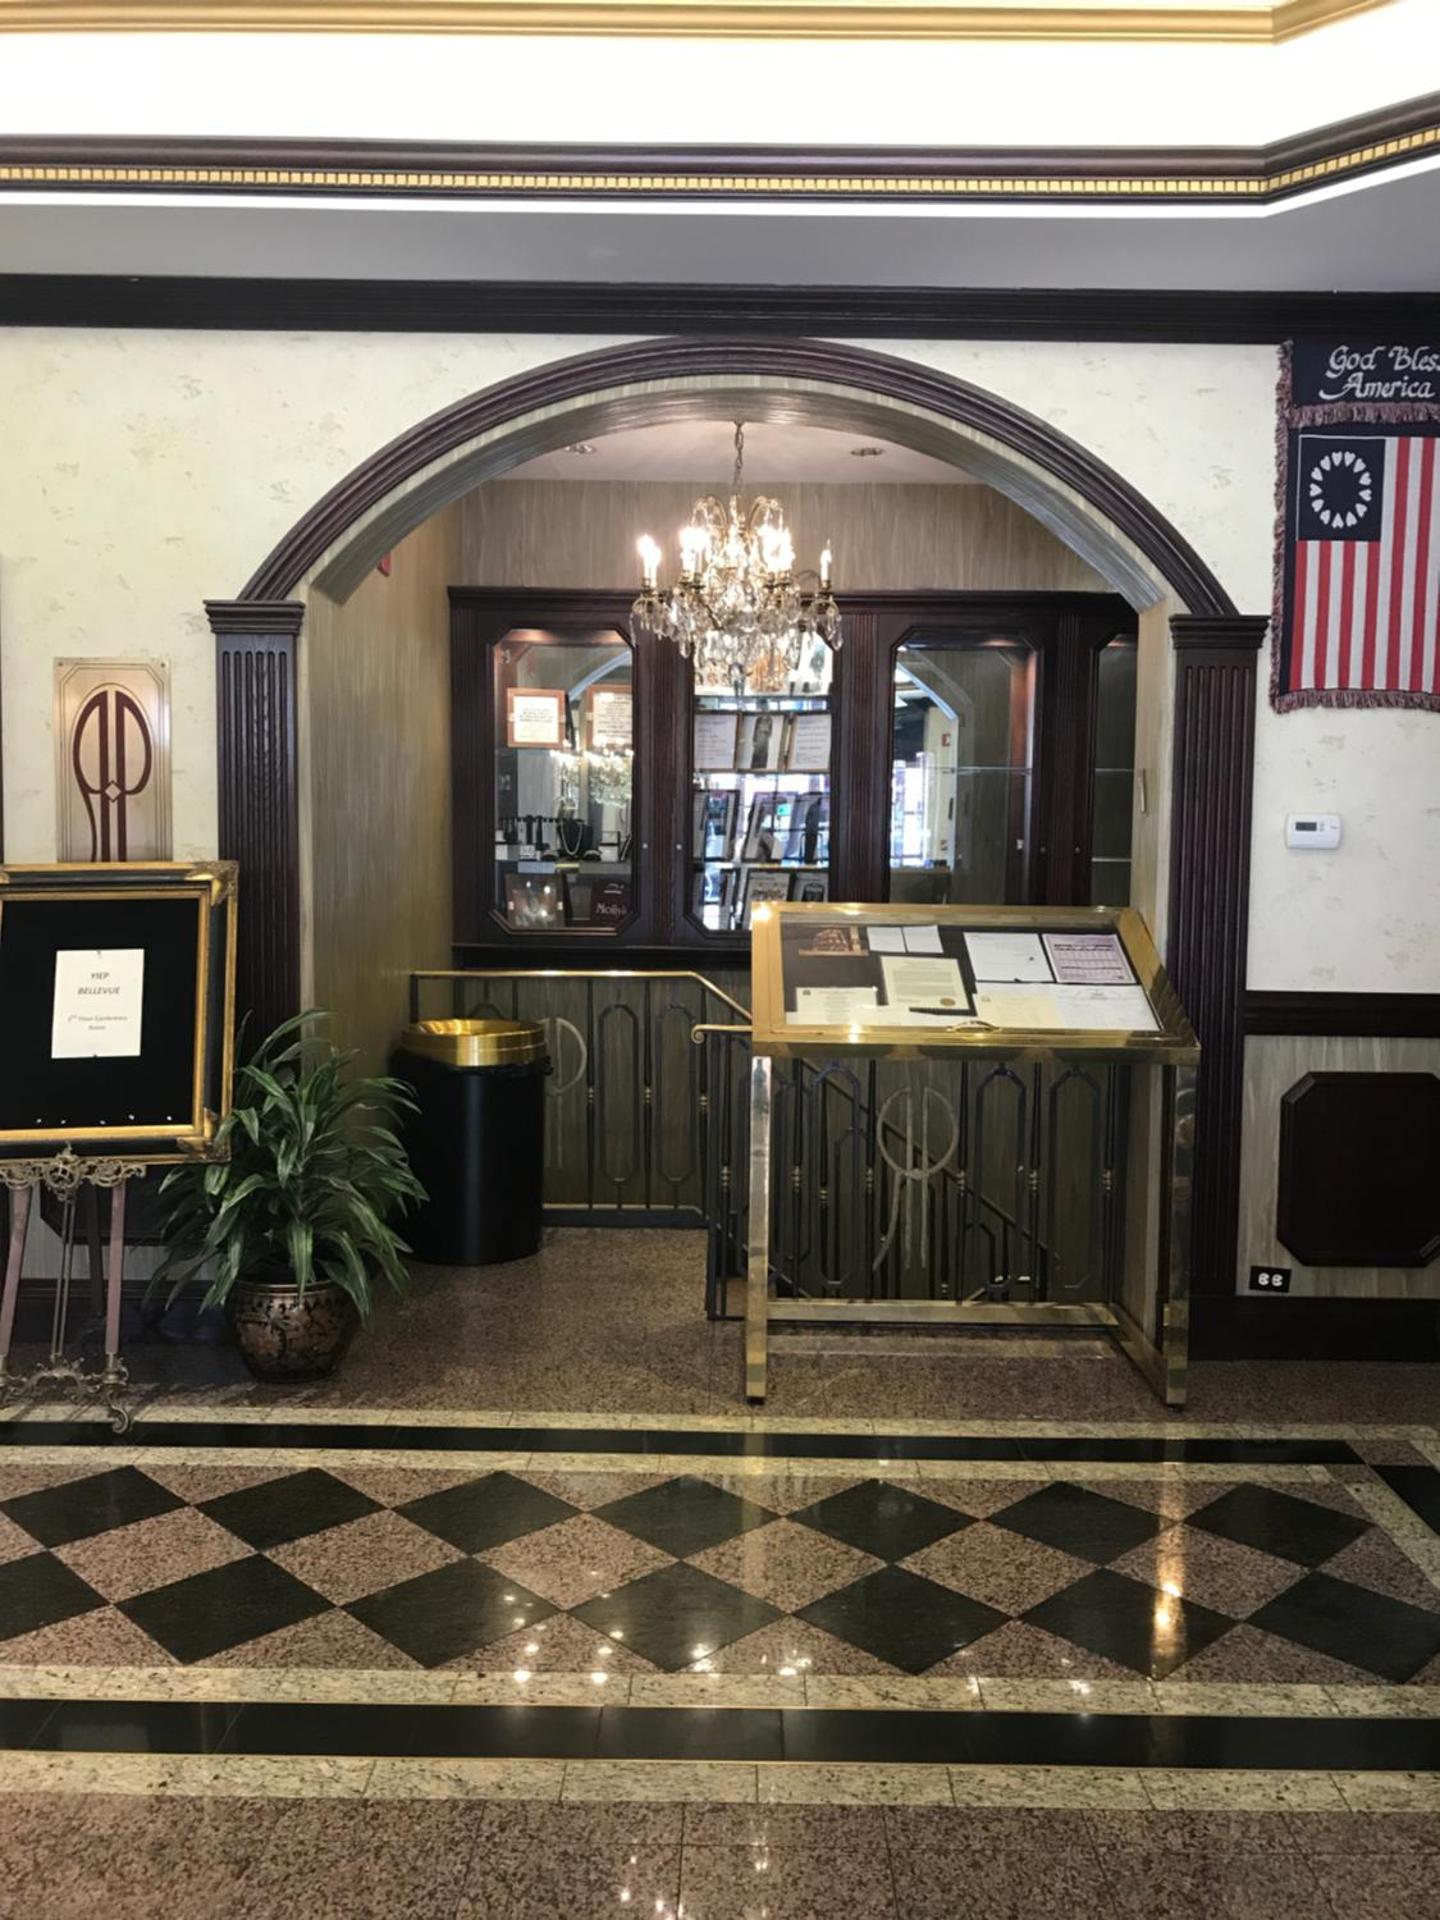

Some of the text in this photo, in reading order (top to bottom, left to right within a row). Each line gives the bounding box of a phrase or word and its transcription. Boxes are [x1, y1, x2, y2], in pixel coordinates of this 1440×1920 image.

[1326, 345, 1440, 378] God Bles
[1318, 371, 1436, 400] America
[77, 986, 120, 995] BELLEVUE
